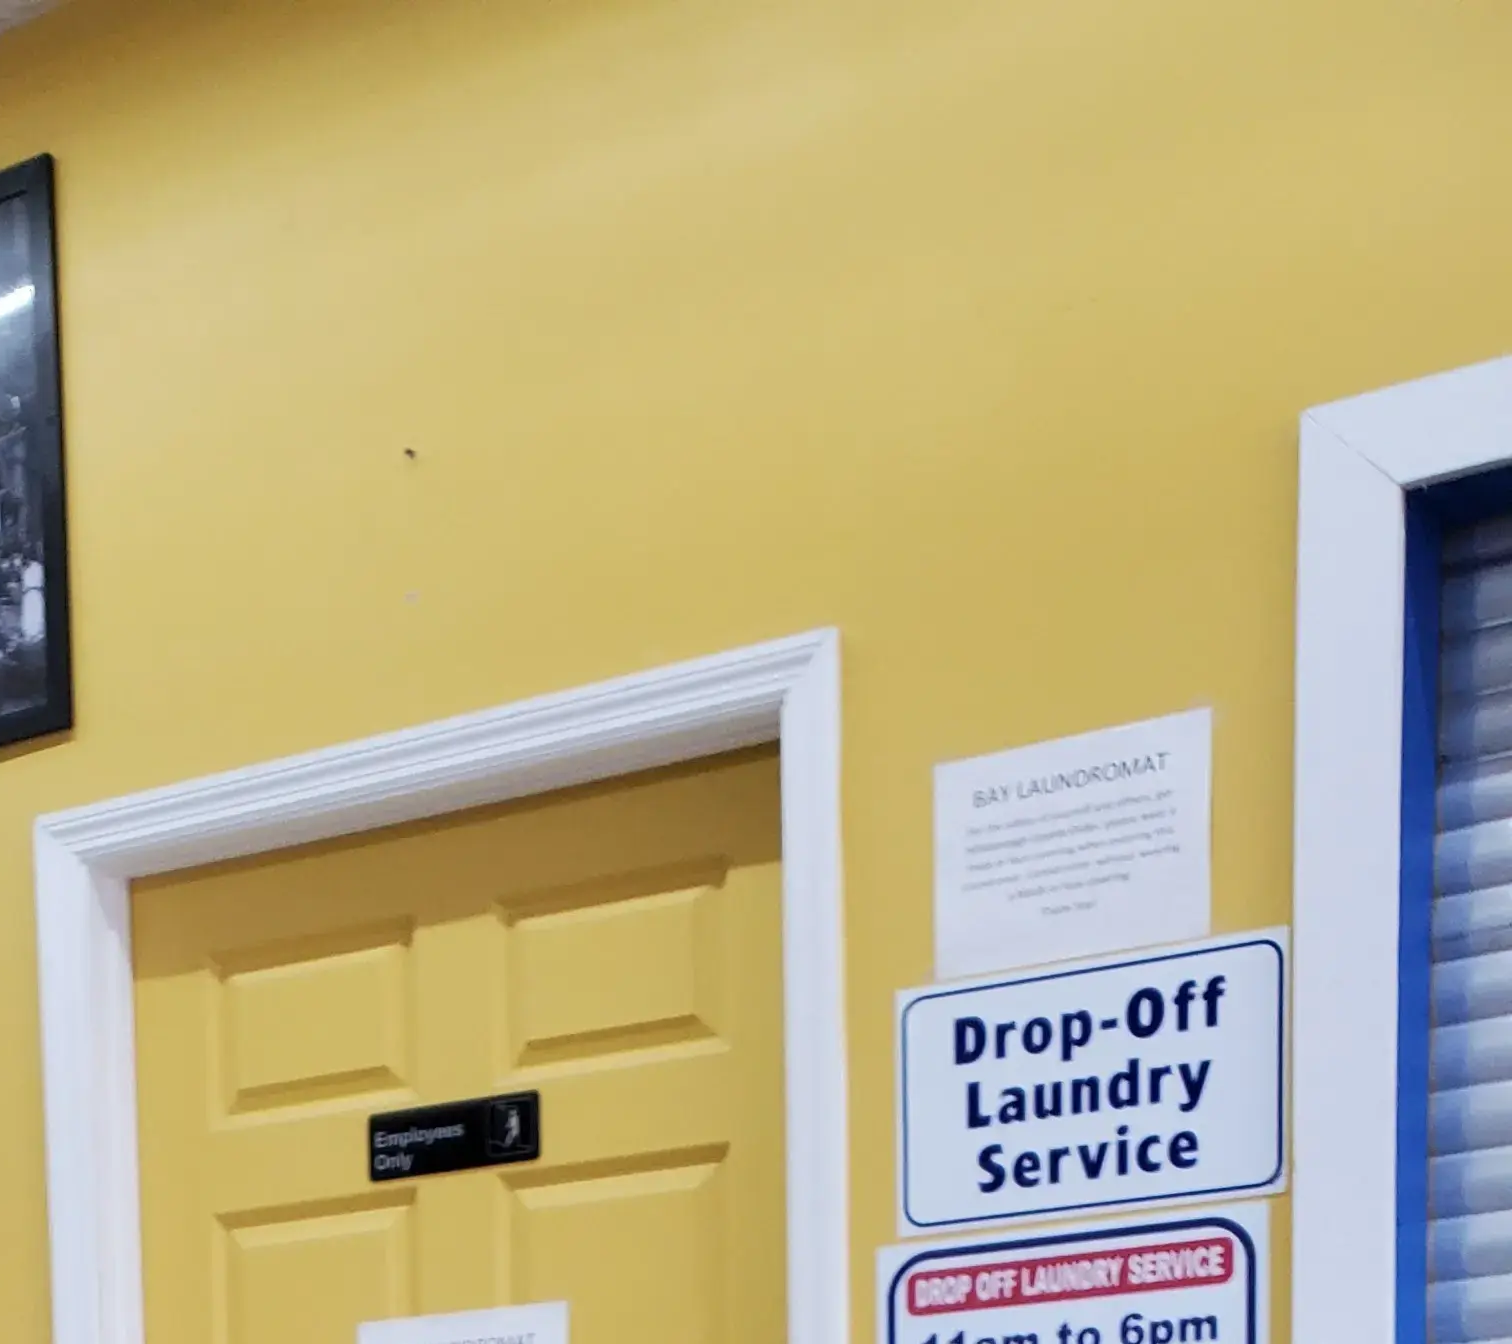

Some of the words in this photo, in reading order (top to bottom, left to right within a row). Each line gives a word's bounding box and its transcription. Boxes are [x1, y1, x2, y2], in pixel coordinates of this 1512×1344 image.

[972, 785, 1009, 808] BAY
[1016, 752, 1170, 800] LAUNDROMAT
[953, 975, 1227, 1066] Drop-Off
[966, 1057, 1212, 1130] Laundry
[373, 1123, 466, 1149] Employees
[373, 1152, 414, 1172] Only
[977, 1124, 1199, 1194] Service
[914, 1275, 973, 1309] DROP
[976, 1269, 1019, 1301] OFF
[1020, 1256, 1125, 1297] LAUNDRY
[1127, 1245, 1226, 1285] SERVICE
